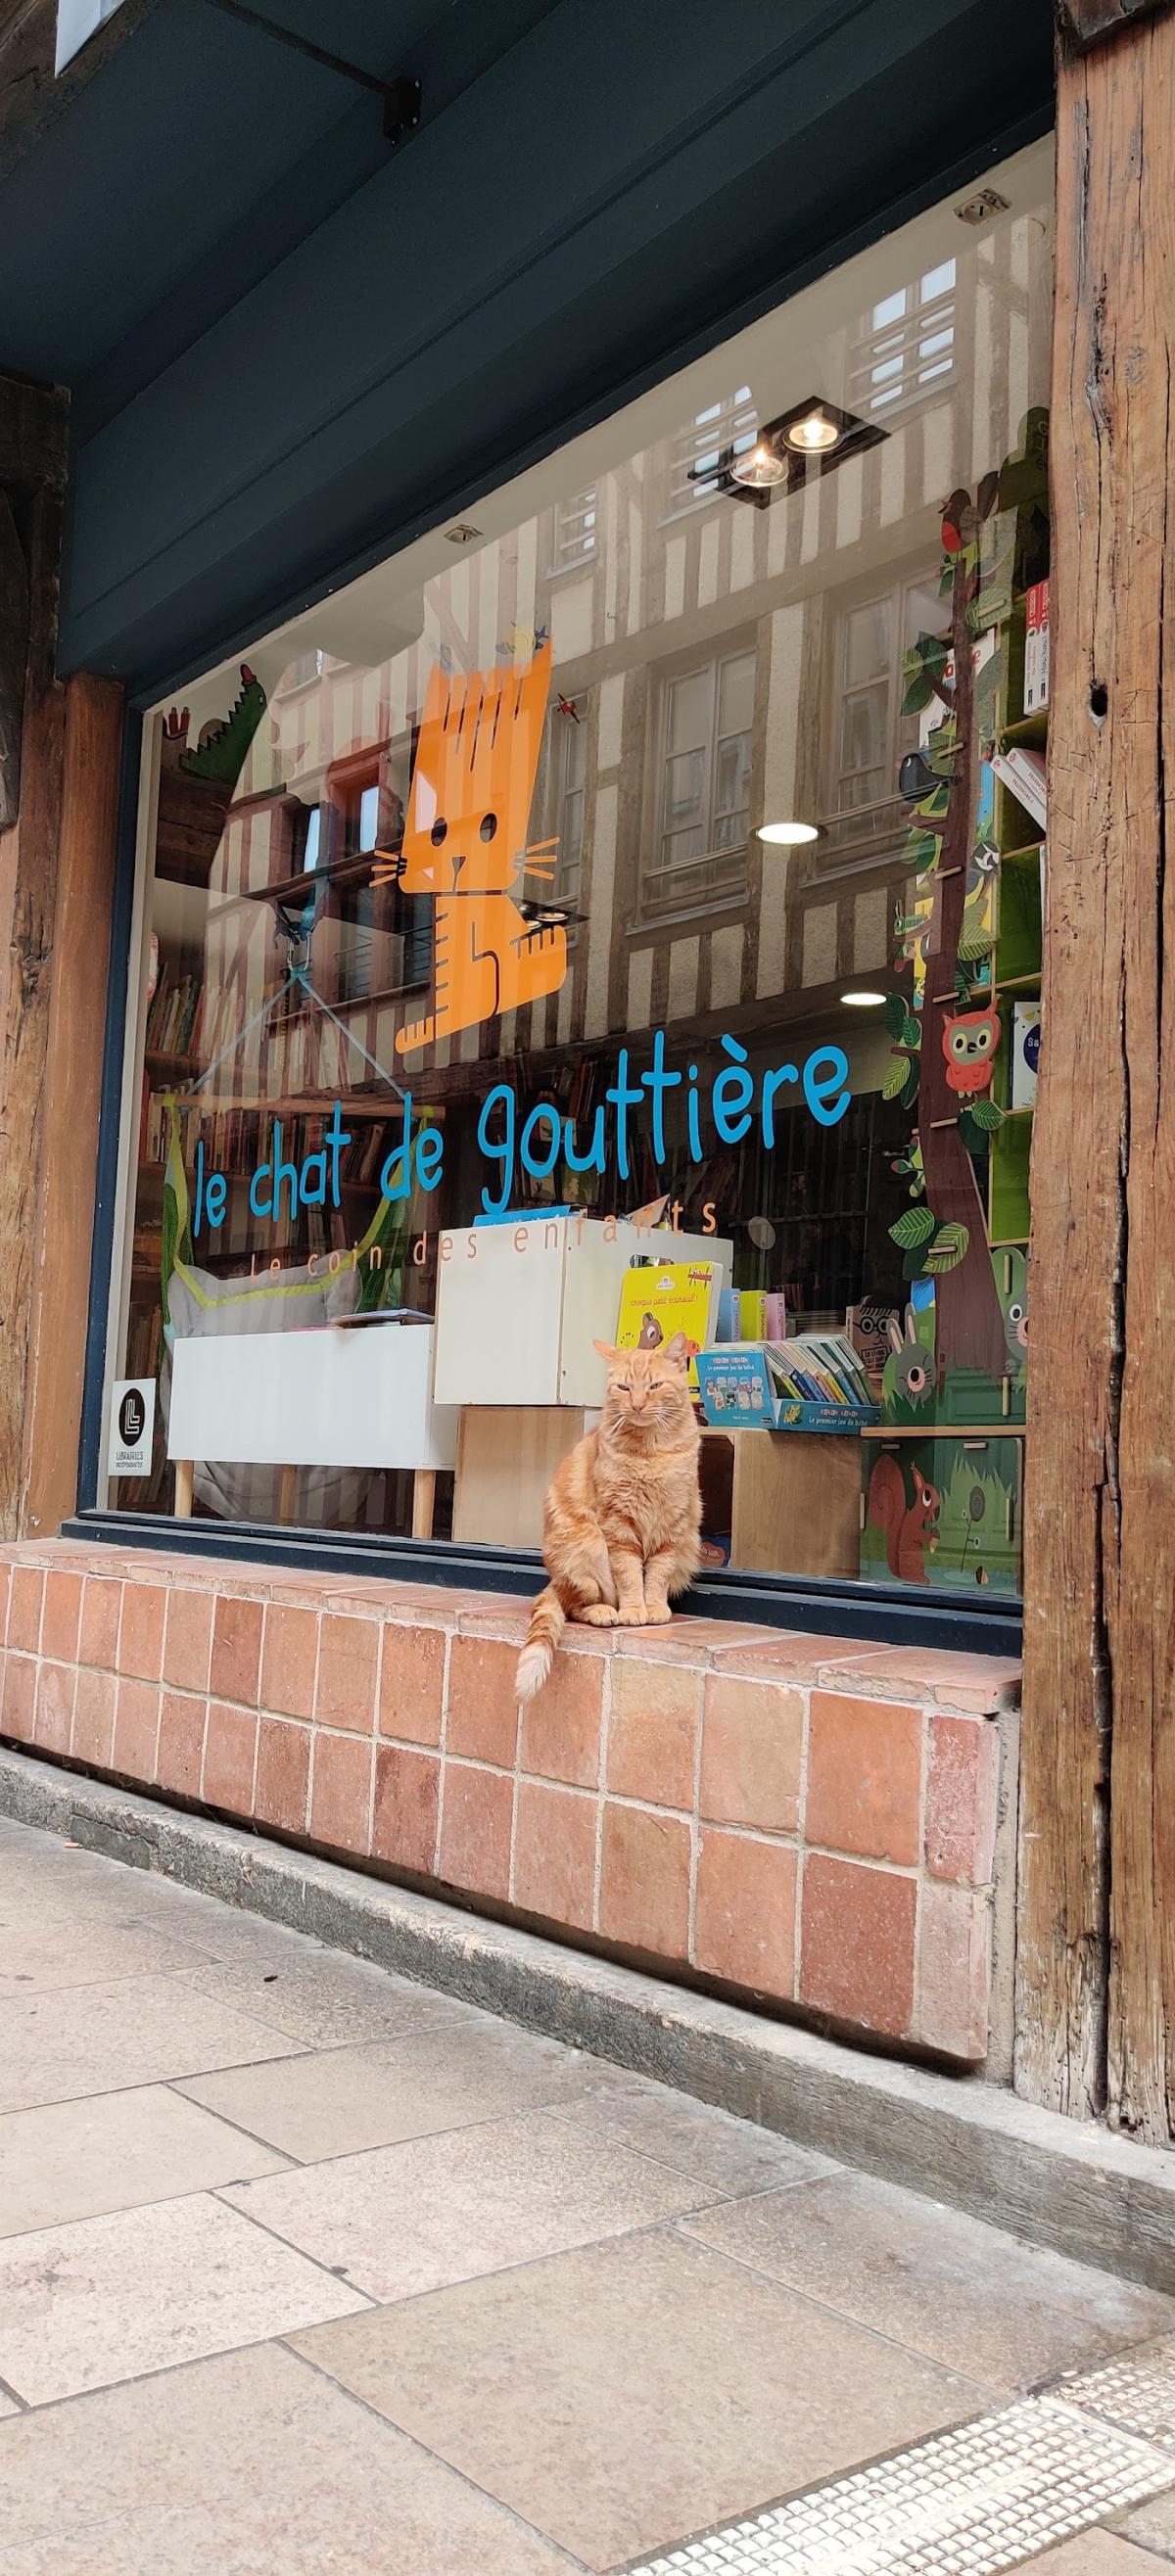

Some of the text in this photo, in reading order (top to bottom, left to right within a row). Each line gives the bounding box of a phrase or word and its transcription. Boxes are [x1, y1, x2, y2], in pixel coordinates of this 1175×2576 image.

[194, 1029, 852, 1238] le chat de gouttière
[307, 1241, 383, 1274] coin
[413, 1231, 478, 1269] des
[513, 1199, 717, 1254] enfants
